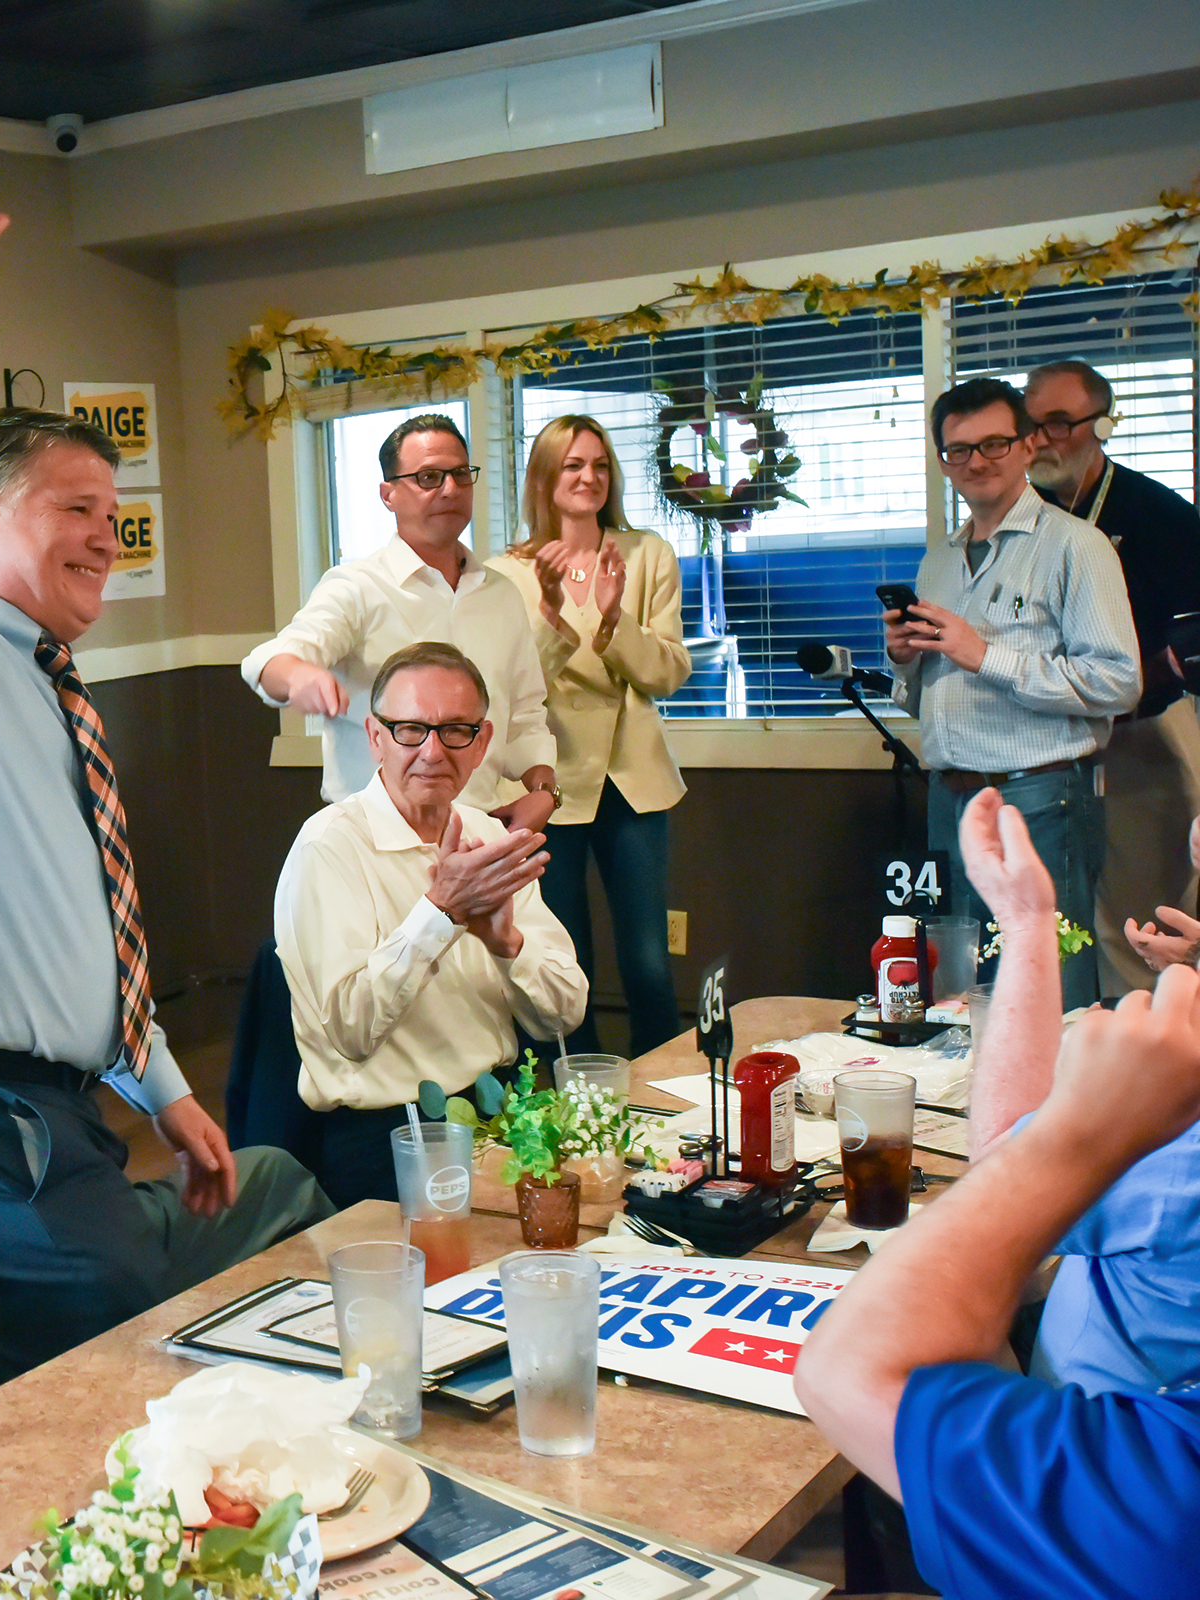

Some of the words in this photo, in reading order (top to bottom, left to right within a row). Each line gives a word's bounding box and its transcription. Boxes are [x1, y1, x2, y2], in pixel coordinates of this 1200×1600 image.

[113, 517, 152, 548] IGE
[885, 860, 942, 907] 34
[700, 967, 725, 1034] 35
[430, 1181, 468, 1195] PEPS
[630, 1264, 716, 1276] JOSH
[727, 1271, 764, 1281] TO
[440, 1288, 693, 1349] DIS
